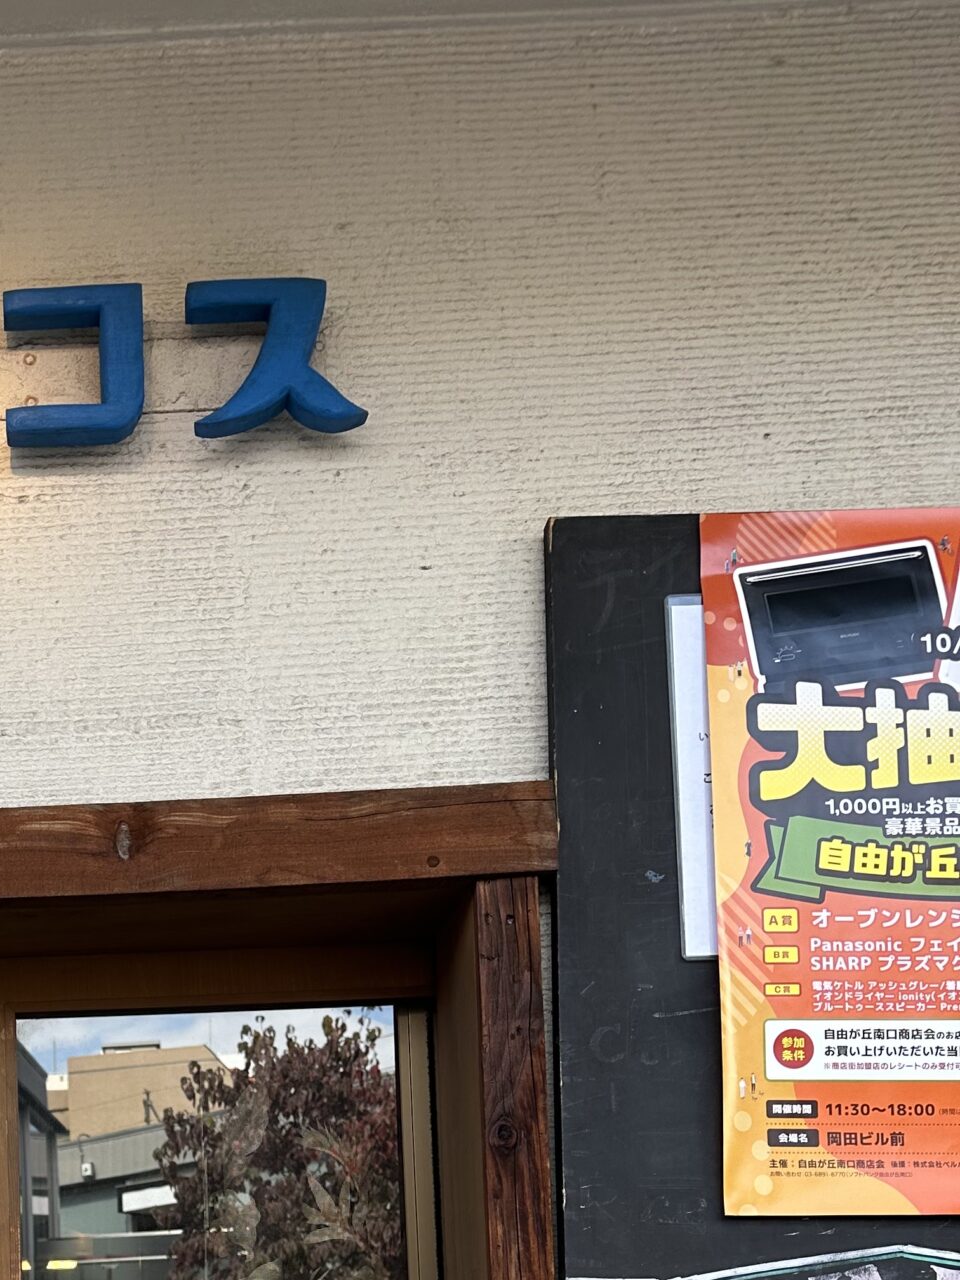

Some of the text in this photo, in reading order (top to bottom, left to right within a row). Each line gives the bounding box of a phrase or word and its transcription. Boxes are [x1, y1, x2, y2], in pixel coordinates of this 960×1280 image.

[757, 681, 960, 800] 大抽
[825, 797, 960, 816] 1,000円以上お買
[885, 818, 960, 835] 豪華景品
[819, 839, 960, 879] 自由が丘
[810, 937, 902, 952] Panasonic
[810, 955, 872, 971] SHARP
[824, 1045, 960, 1057] お買い上げいただいた当
[826, 1131, 905, 1147] 岡田ビル前
